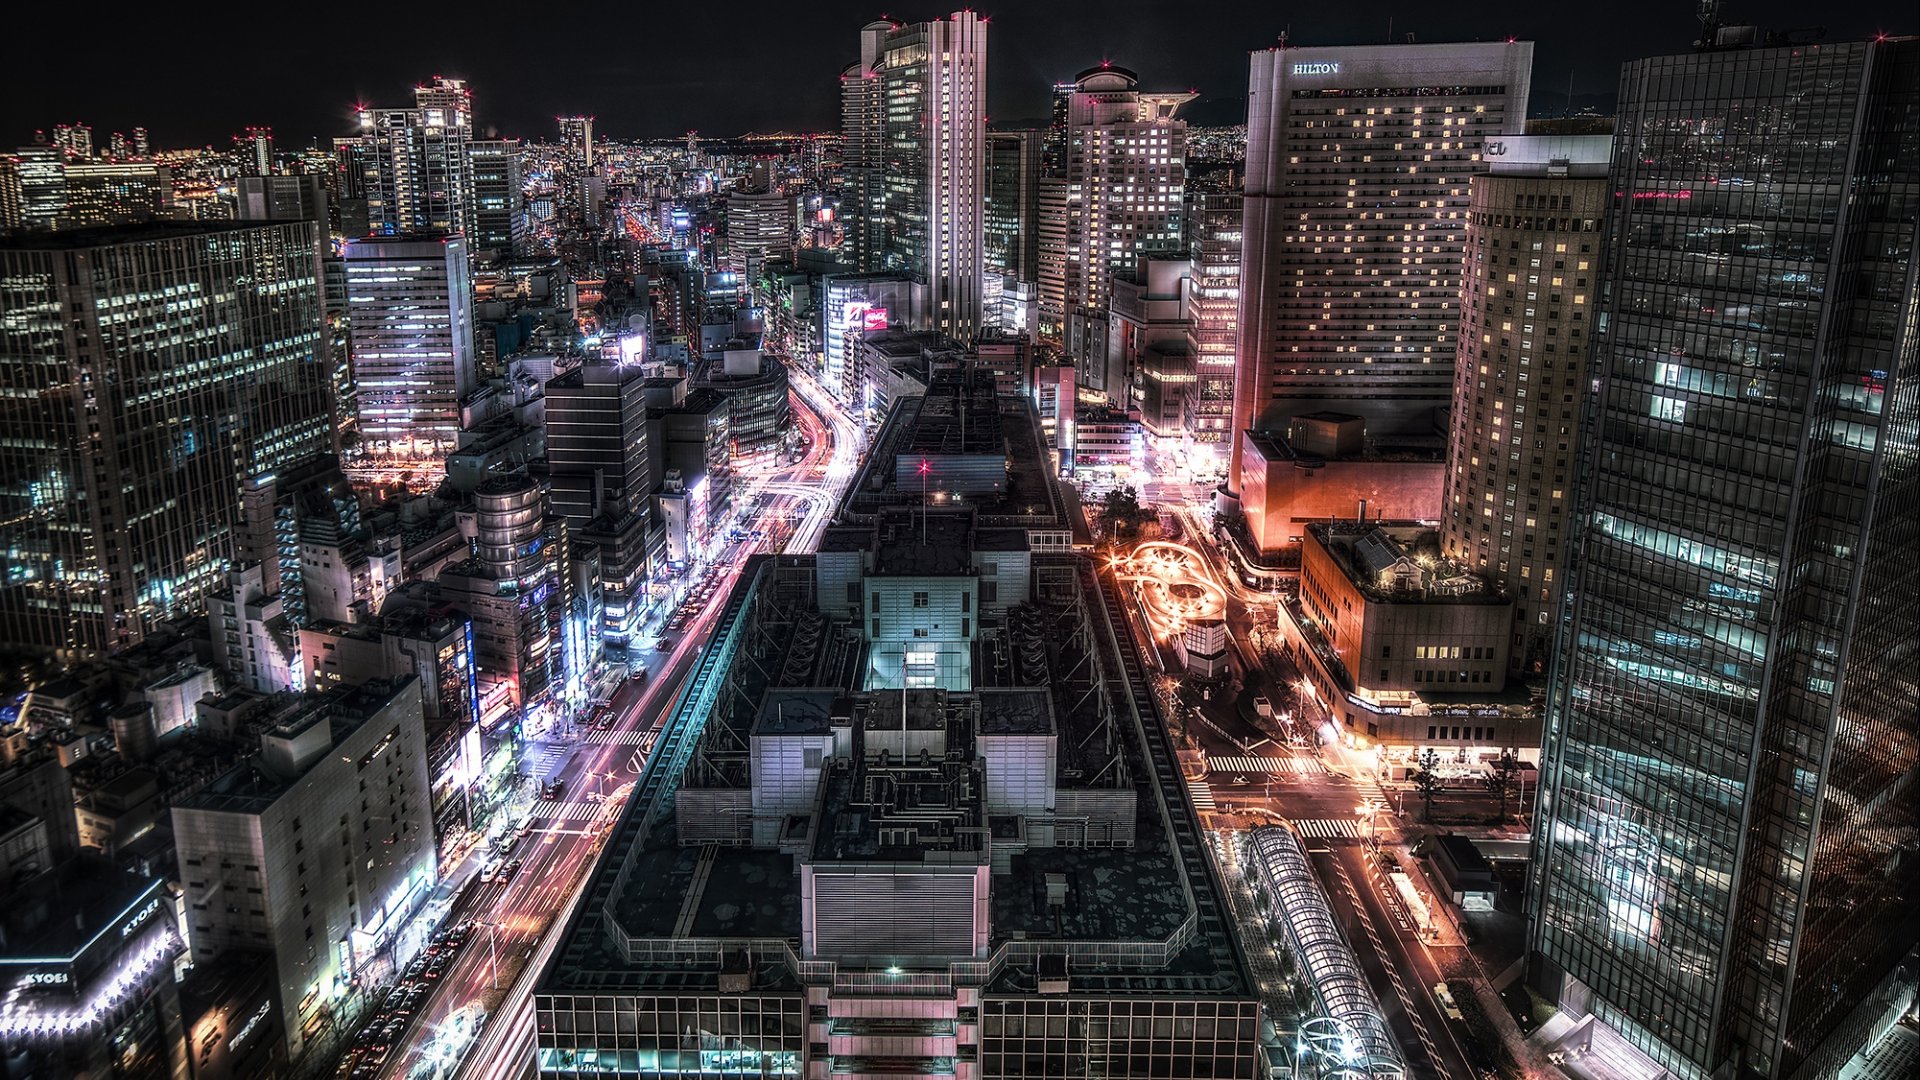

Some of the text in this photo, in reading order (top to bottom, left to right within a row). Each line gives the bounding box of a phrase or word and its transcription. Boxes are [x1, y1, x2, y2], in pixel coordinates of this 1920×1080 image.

[1293, 63, 1339, 74] HILTON
[122, 898, 159, 936] KYOEI
[24, 973, 68, 984] KYOEI
